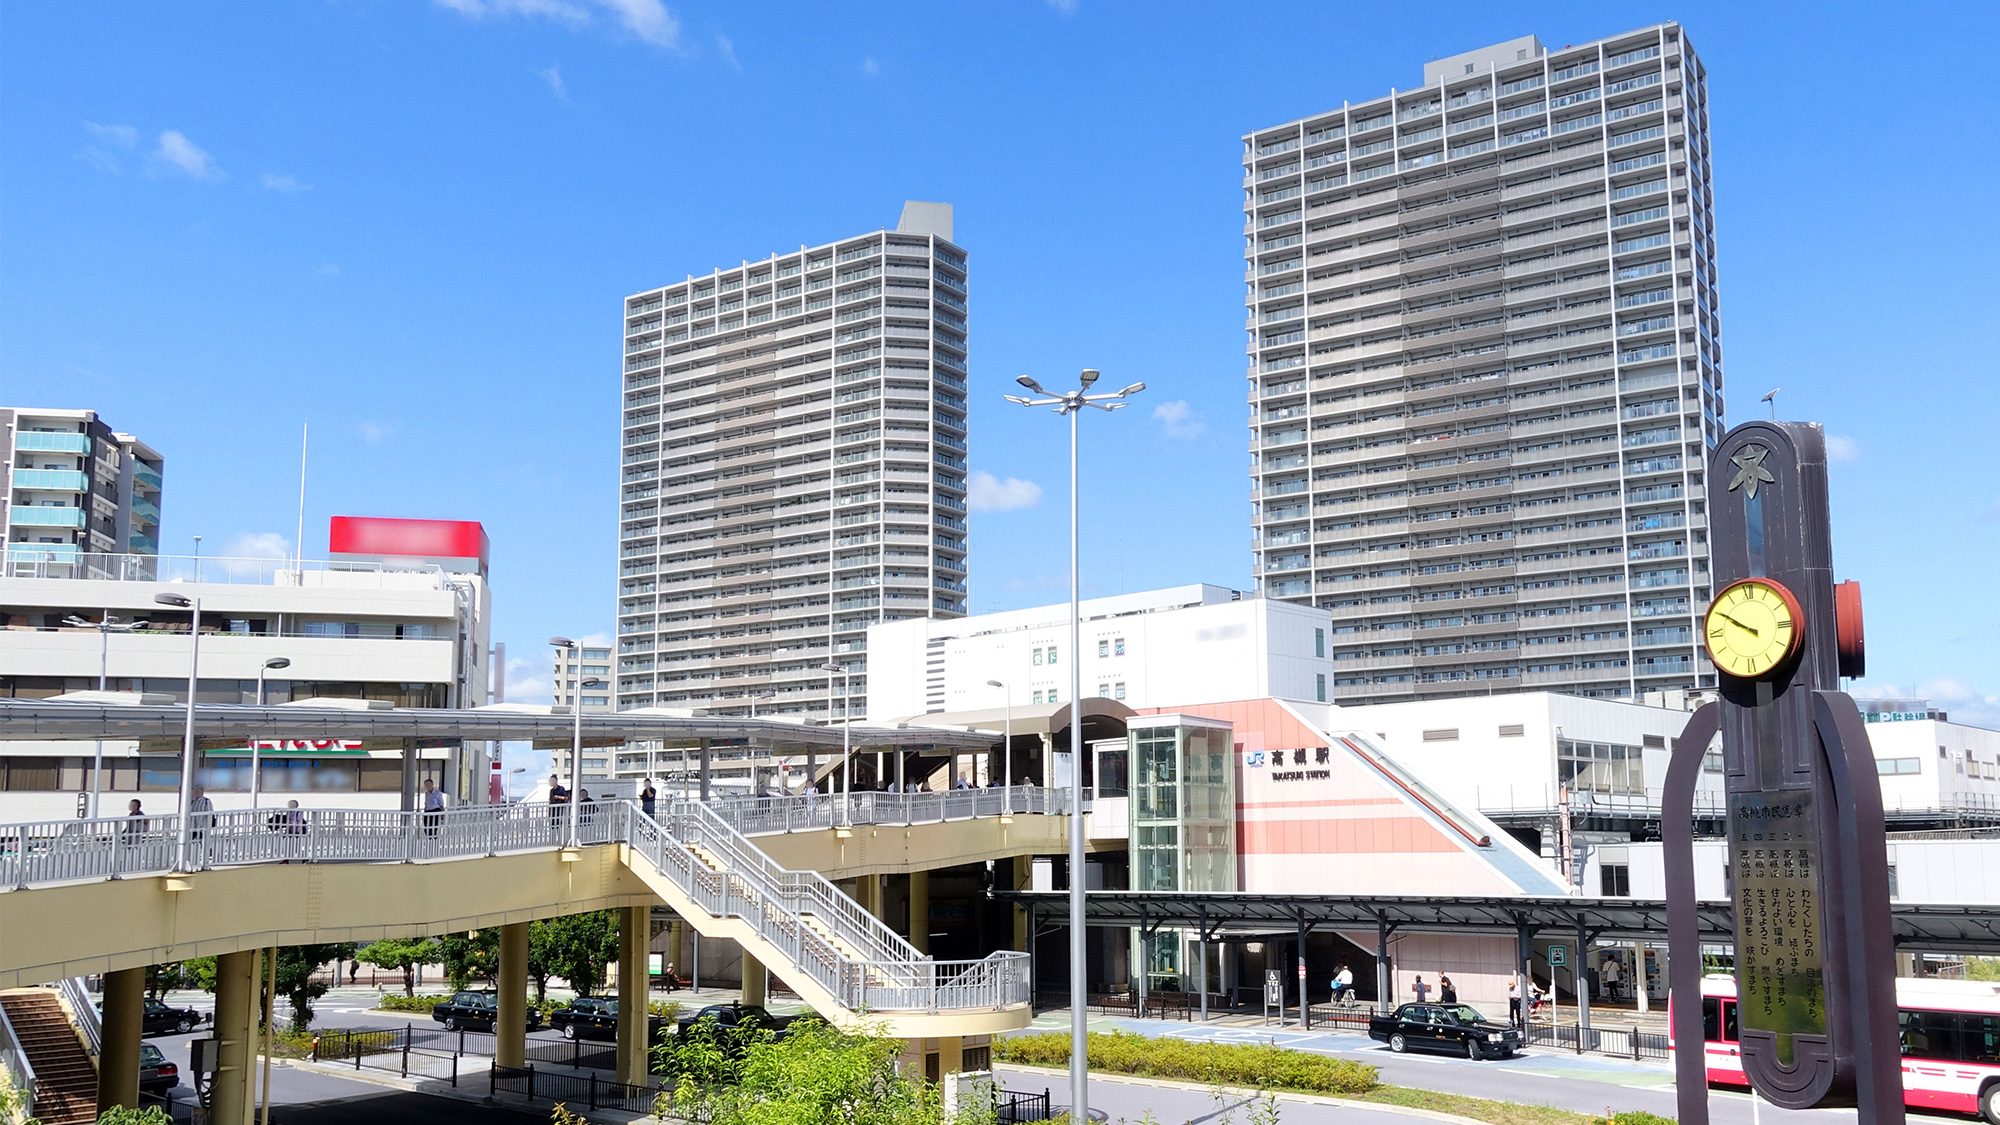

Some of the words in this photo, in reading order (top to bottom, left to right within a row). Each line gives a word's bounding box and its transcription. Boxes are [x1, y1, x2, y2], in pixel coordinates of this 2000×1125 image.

[1860, 711, 1926, 722] 前P駐輪場
[1247, 750, 1264, 765] JR
[1271, 748, 1329, 767] 高槻駅
[1271, 771, 1304, 782] TAKATSUKI
[1306, 769, 1331, 780] STATION
[1739, 804, 1805, 819] 高槻市民憲章
[1741, 833, 1749, 841] 五
[1754, 833, 1763, 841] 四
[1769, 832, 1776, 841] 三
[1743, 888, 1753, 936] 文化の華を
[1757, 888, 1769, 956] 生きるよろこび
[1771, 888, 1783, 946] 住みよい環境
[1786, 888, 1797, 928] 心と心を
[1801, 889, 1814, 957] わたくしたちの
[1746, 946, 1757, 995] 咲かすまち
[1789, 938, 1800, 977] 結ぶまち
[1762, 966, 1773, 1015] 燃やすまち
[1776, 957, 1787, 1006] めざすまち
[1806, 968, 1817, 1018] 自治のまち
